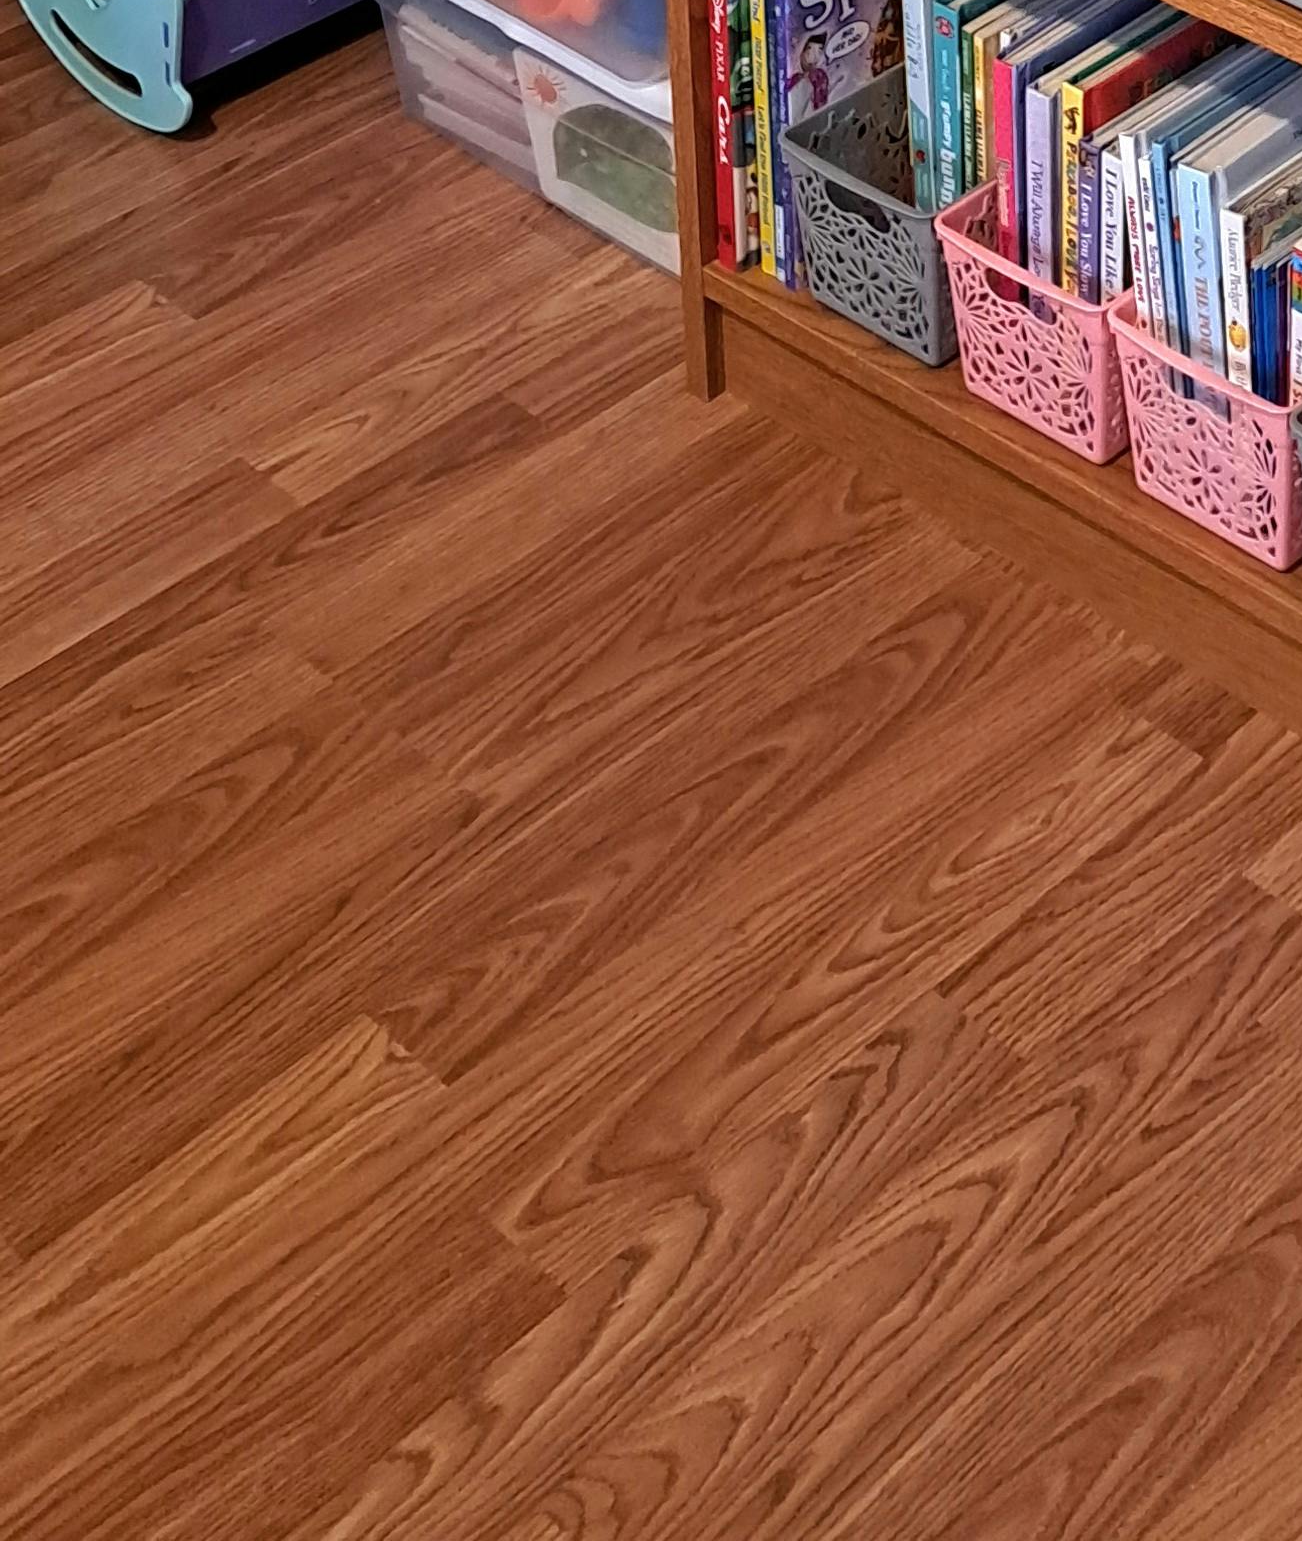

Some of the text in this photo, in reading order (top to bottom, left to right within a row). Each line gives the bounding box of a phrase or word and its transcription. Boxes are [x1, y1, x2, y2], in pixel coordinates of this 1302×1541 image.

[715, 40, 725, 83] PIXAR
[717, 97, 731, 166] Cars
[940, 99, 953, 148] grumpy
[963, 92, 972, 157] LLAMA LLAMA
[1030, 161, 1044, 255] I Will Always
[1080, 182, 1092, 192] I
[1080, 192, 1092, 228] Love
[1080, 231, 1093, 258] You
[1105, 168, 1118, 290] I Love You Like
[1127, 196, 1146, 303] ALWAYS MORE LOVE
[1195, 276, 1210, 309] THE
[1227, 228, 1242, 311] Maurice Pledger
